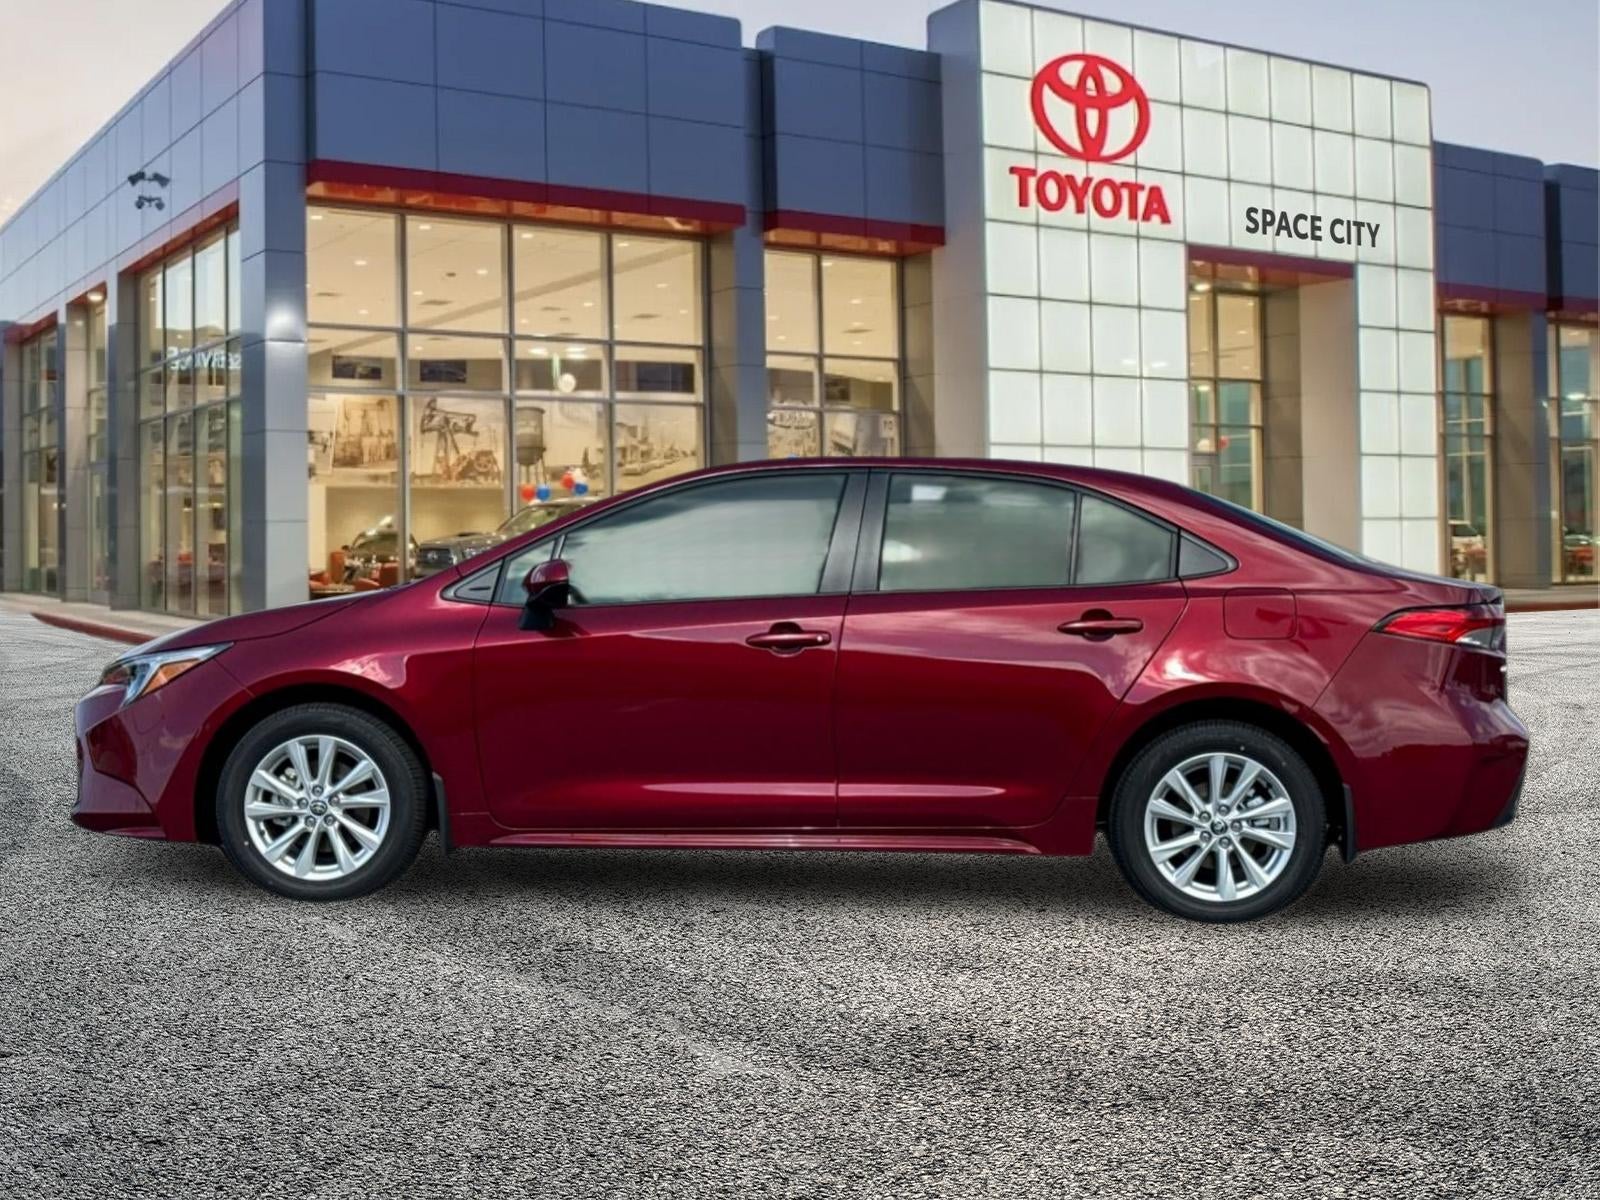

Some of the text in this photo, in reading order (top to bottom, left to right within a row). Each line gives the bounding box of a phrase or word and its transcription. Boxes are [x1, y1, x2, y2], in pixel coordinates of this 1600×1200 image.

[1009, 166, 1171, 224] TOYOTA
[1245, 206, 1381, 248] SPACE CITY
